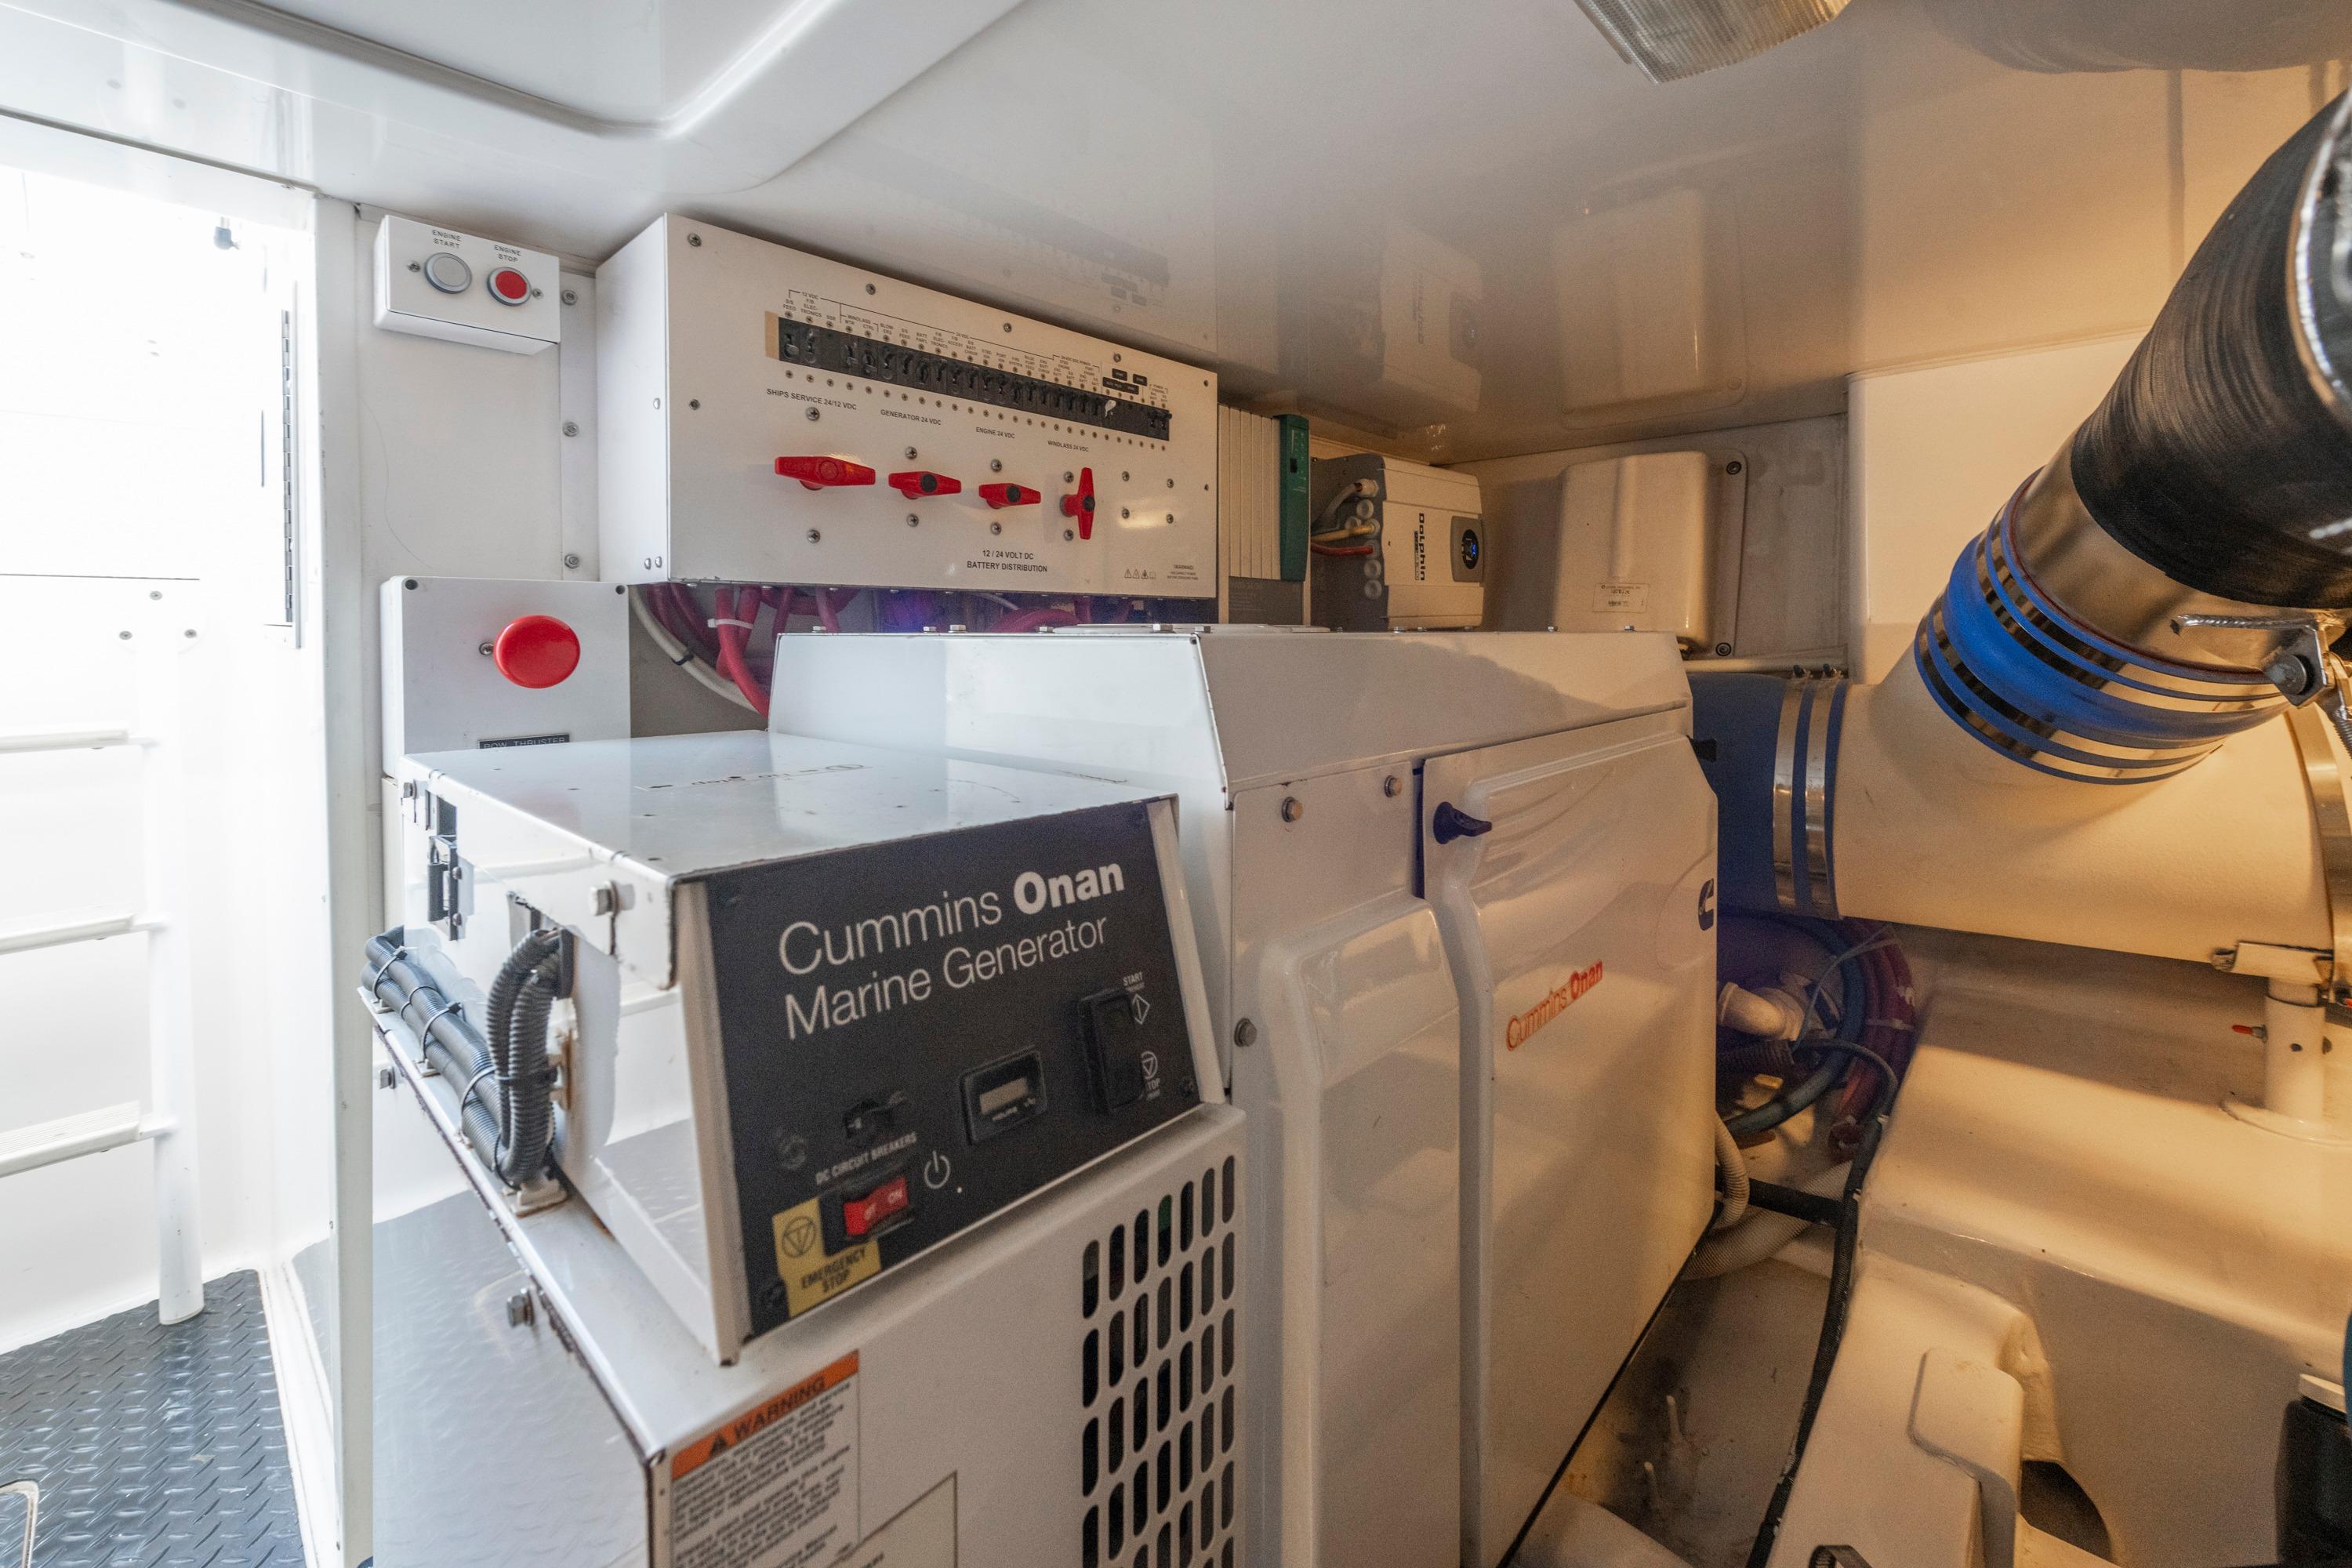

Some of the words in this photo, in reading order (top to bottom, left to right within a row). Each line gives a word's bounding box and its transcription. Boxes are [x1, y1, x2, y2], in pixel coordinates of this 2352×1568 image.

[432, 230, 462, 241] ENGINE
[434, 238, 459, 249] START
[494, 245, 521, 256] ENGINE
[498, 253, 518, 262] STOP
[800, 308, 822, 318] TRONICS
[767, 388, 789, 398] SHIPS
[790, 393, 822, 405] SERVICE
[823, 398, 841, 408] 24/12
[880, 409, 920, 422] GENERATOR
[975, 426, 996, 436] ENGINE
[1047, 440, 1073, 450] WINDLASS
[1005, 551, 1023, 560] VOLT
[967, 561, 1000, 570] BATTERY
[1001, 562, 1047, 572] DISTRIBUTION
[779, 891, 1003, 975] Cummins
[1013, 862, 1125, 914] Onan
[786, 963, 932, 1040] Marine
[943, 916, 1107, 989] Generator
[1123, 971, 1143, 987] START
[1505, 987, 1567, 1052] Cummins
[1570, 959, 1604, 1001] Onan
[1148, 1077, 1160, 1091] TOP
[815, 1168, 830, 1185] DC
[831, 1152, 869, 1178] CIRCUIT
[870, 1131, 917, 1161] BREAKERS
[800, 1247, 866, 1288] EMERGENCY
[822, 1268, 851, 1293] STOP
[734, 1377, 826, 1441] WARNING
